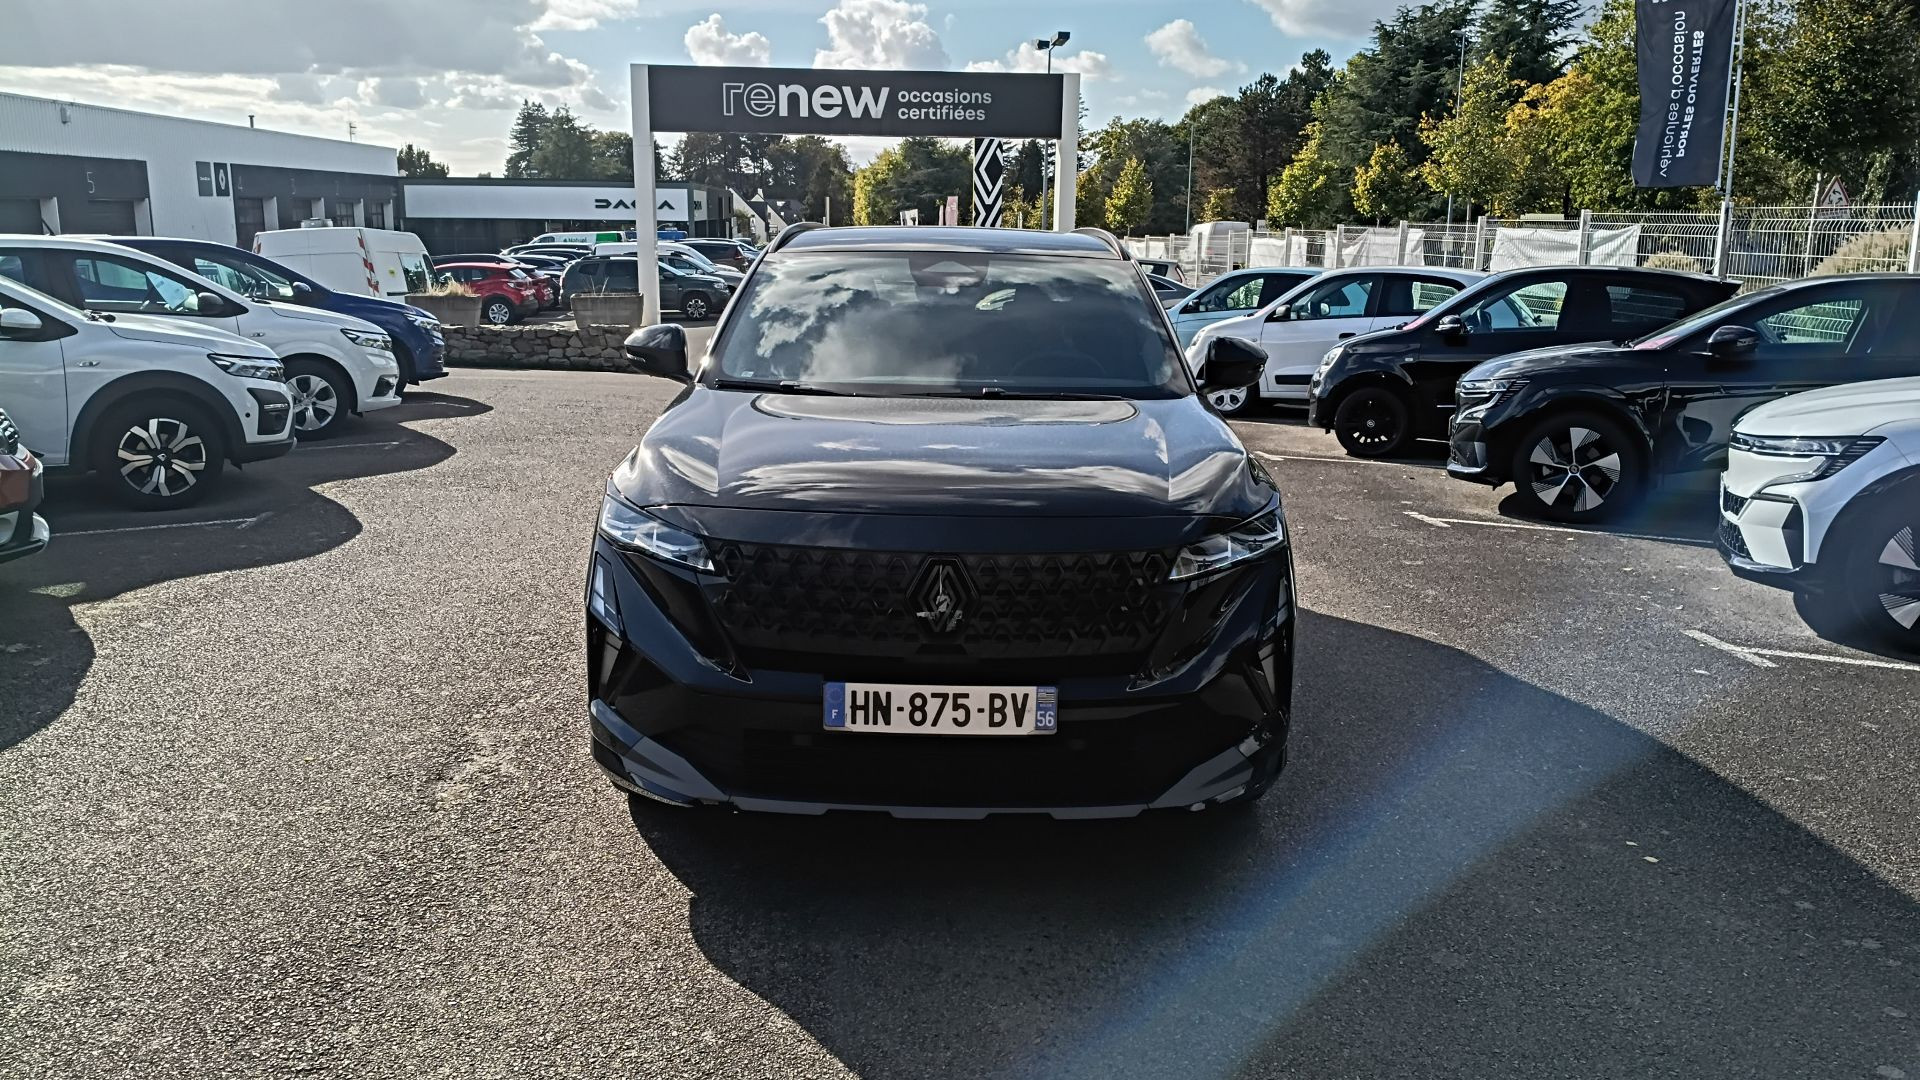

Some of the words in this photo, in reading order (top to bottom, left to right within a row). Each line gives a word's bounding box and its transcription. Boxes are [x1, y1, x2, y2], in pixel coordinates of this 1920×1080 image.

[722, 82, 890, 119] renew
[897, 88, 993, 105] occasions
[897, 105, 986, 121] certifiées
[86, 171, 95, 194] 5
[594, 198, 675, 210] DAA
[831, 709, 839, 719] F
[850, 690, 1030, 728] HN-875-BV
[1036, 711, 1055, 727] 56
